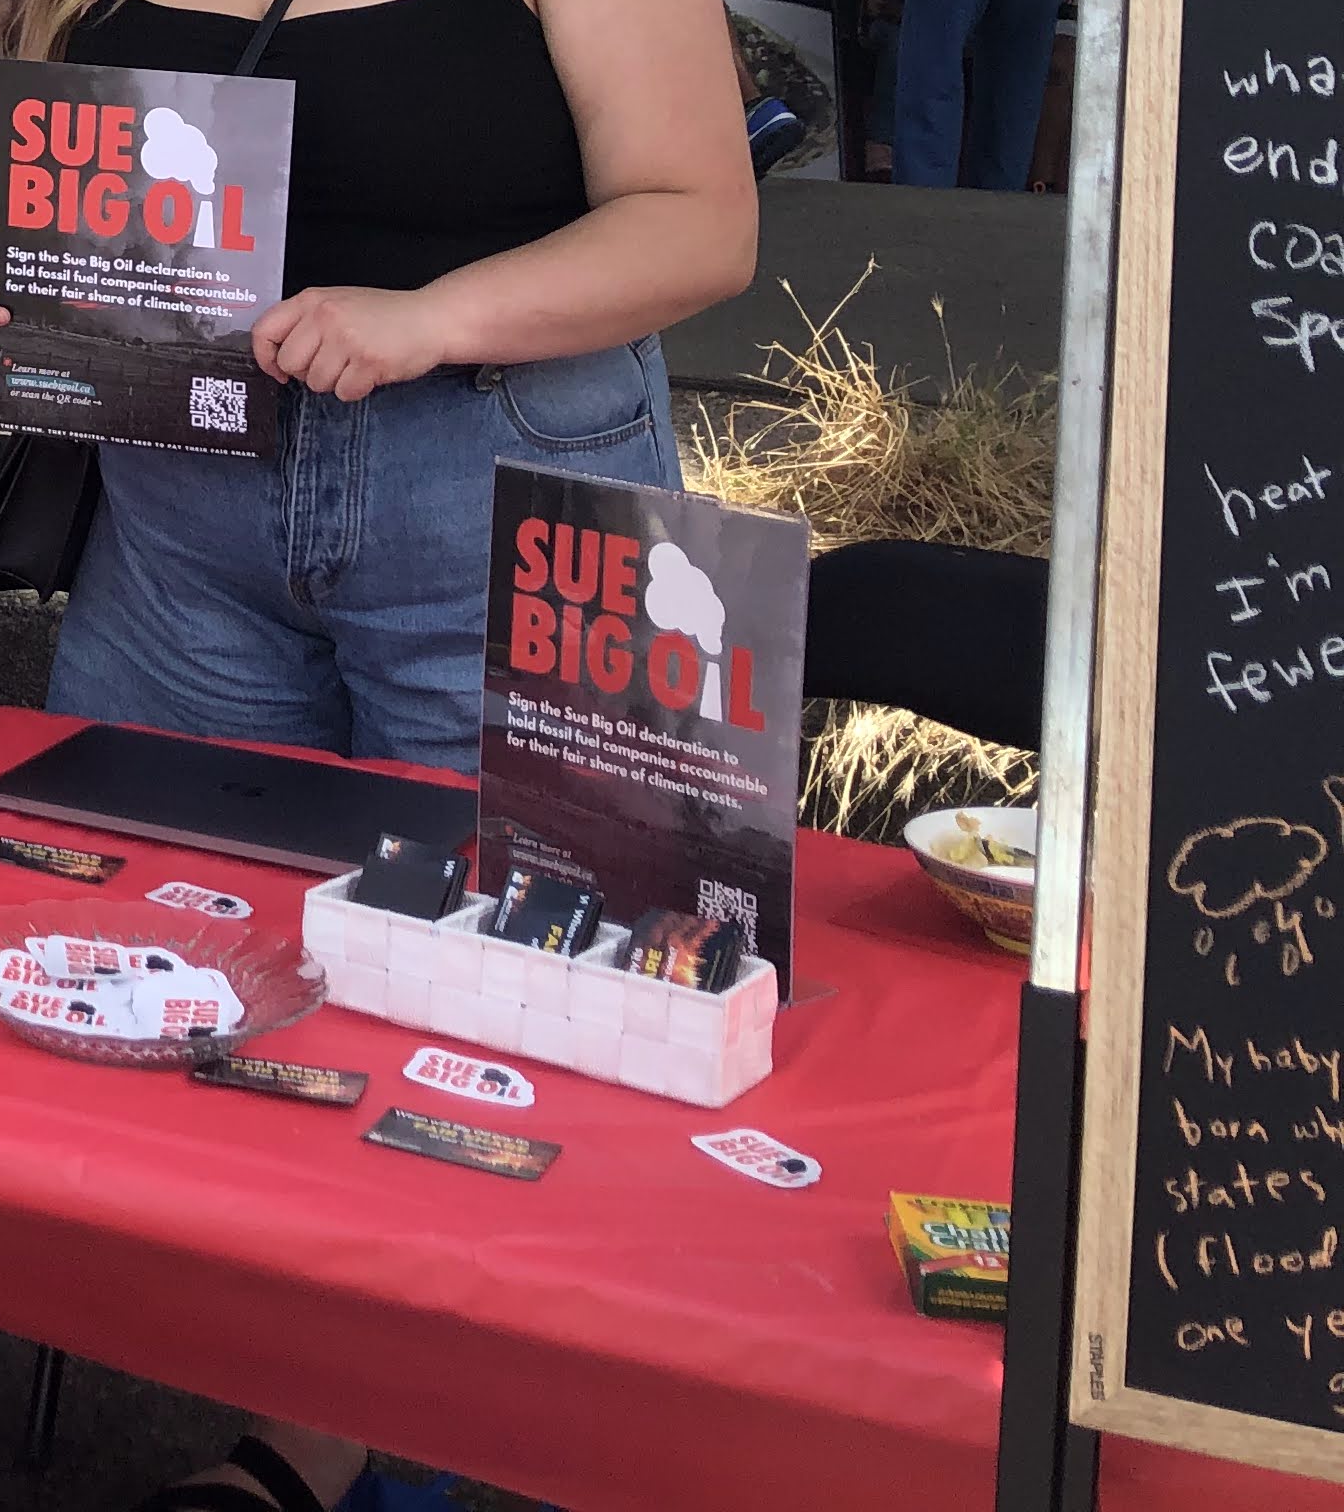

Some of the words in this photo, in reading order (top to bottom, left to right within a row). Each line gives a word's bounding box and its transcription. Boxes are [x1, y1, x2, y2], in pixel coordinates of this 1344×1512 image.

[11, 98, 136, 172] SUE
[8, 163, 130, 237] BIG
[143, 179, 255, 252] OIL
[6, 246, 35, 262] Sign
[39, 251, 59, 263] the
[62, 252, 87, 266] Sue
[90, 255, 111, 271] Big
[114, 258, 133, 272] Oil
[136, 263, 213, 281] declaration
[216, 270, 229, 282] to
[6, 263, 35, 277] hold
[38, 266, 70, 282] fossil
[73, 269, 98, 285] fuel
[101, 276, 171, 293] companies
[175, 284, 257, 303] accountable
[5, 280, 25, 292] for
[28, 282, 59, 296] their
[61, 287, 85, 300] fair
[88, 290, 125, 305] share
[128, 294, 142, 307] of
[144, 296, 193, 313] climate
[195, 305, 233, 317] costs.
[11, 377, 91, 394] www.suebigoil.ca
[12, 363, 36, 373] Learn
[39, 368, 59, 376] more
[61, 370, 70, 378] at
[10, 389, 20, 397] or
[21, 390, 39, 399] scan
[42, 392, 55, 401] the
[57, 394, 71, 404] QR
[73, 397, 91, 405] code
[1203, 455, 1332, 536] heat
[514, 517, 640, 616] SUE
[1215, 554, 1330, 622] I'm
[510, 592, 633, 694] BIG
[647, 632, 766, 732] OIL
[507, 710, 536, 732] hold
[539, 718, 572, 741] fossil
[575, 728, 600, 749] fuel
[603, 740, 676, 770] companies
[680, 761, 767, 796] accountable
[509, 691, 537, 712] Sign
[540, 699, 561, 718] the
[564, 706, 589, 725] Sue
[592, 712, 613, 735] Big
[617, 720, 636, 738] Oil
[639, 726, 720, 761] declaration
[723, 749, 738, 766] to
[507, 731, 526, 748] for
[529, 736, 560, 758] their
[563, 746, 586, 765] fair
[589, 755, 627, 778] share
[631, 768, 646, 783] of
[648, 772, 699, 798] climate
[702, 789, 742, 811] costs.
[2, 968, 51, 986] BIG
[417, 1065, 470, 1088] BIG
[427, 1054, 480, 1075] SUE
[1163, 1025, 1233, 1087] My
[1248, 1037, 1341, 1102] baby
[1173, 1098, 1270, 1146] born
[1164, 1161, 1326, 1213] states
[1177, 1316, 1251, 1351] one
[1089, 1332, 1105, 1400] STAPLES
